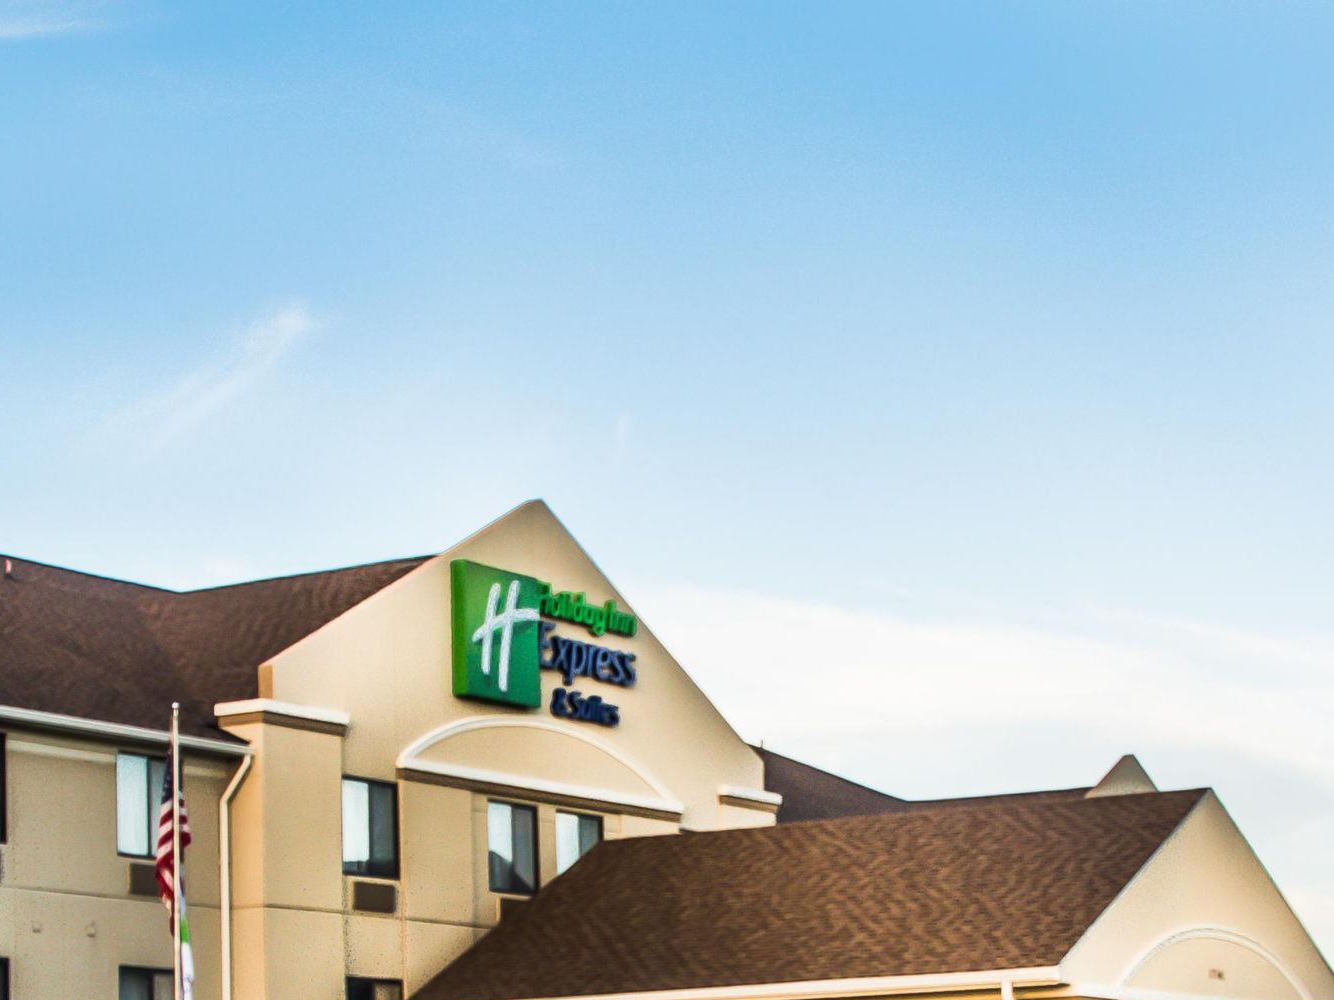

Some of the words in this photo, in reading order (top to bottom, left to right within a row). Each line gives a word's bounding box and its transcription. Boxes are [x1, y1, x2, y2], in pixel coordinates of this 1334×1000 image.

[539, 579, 605, 637] Holiday
[604, 599, 637, 637] Inn
[539, 621, 637, 687] Express
